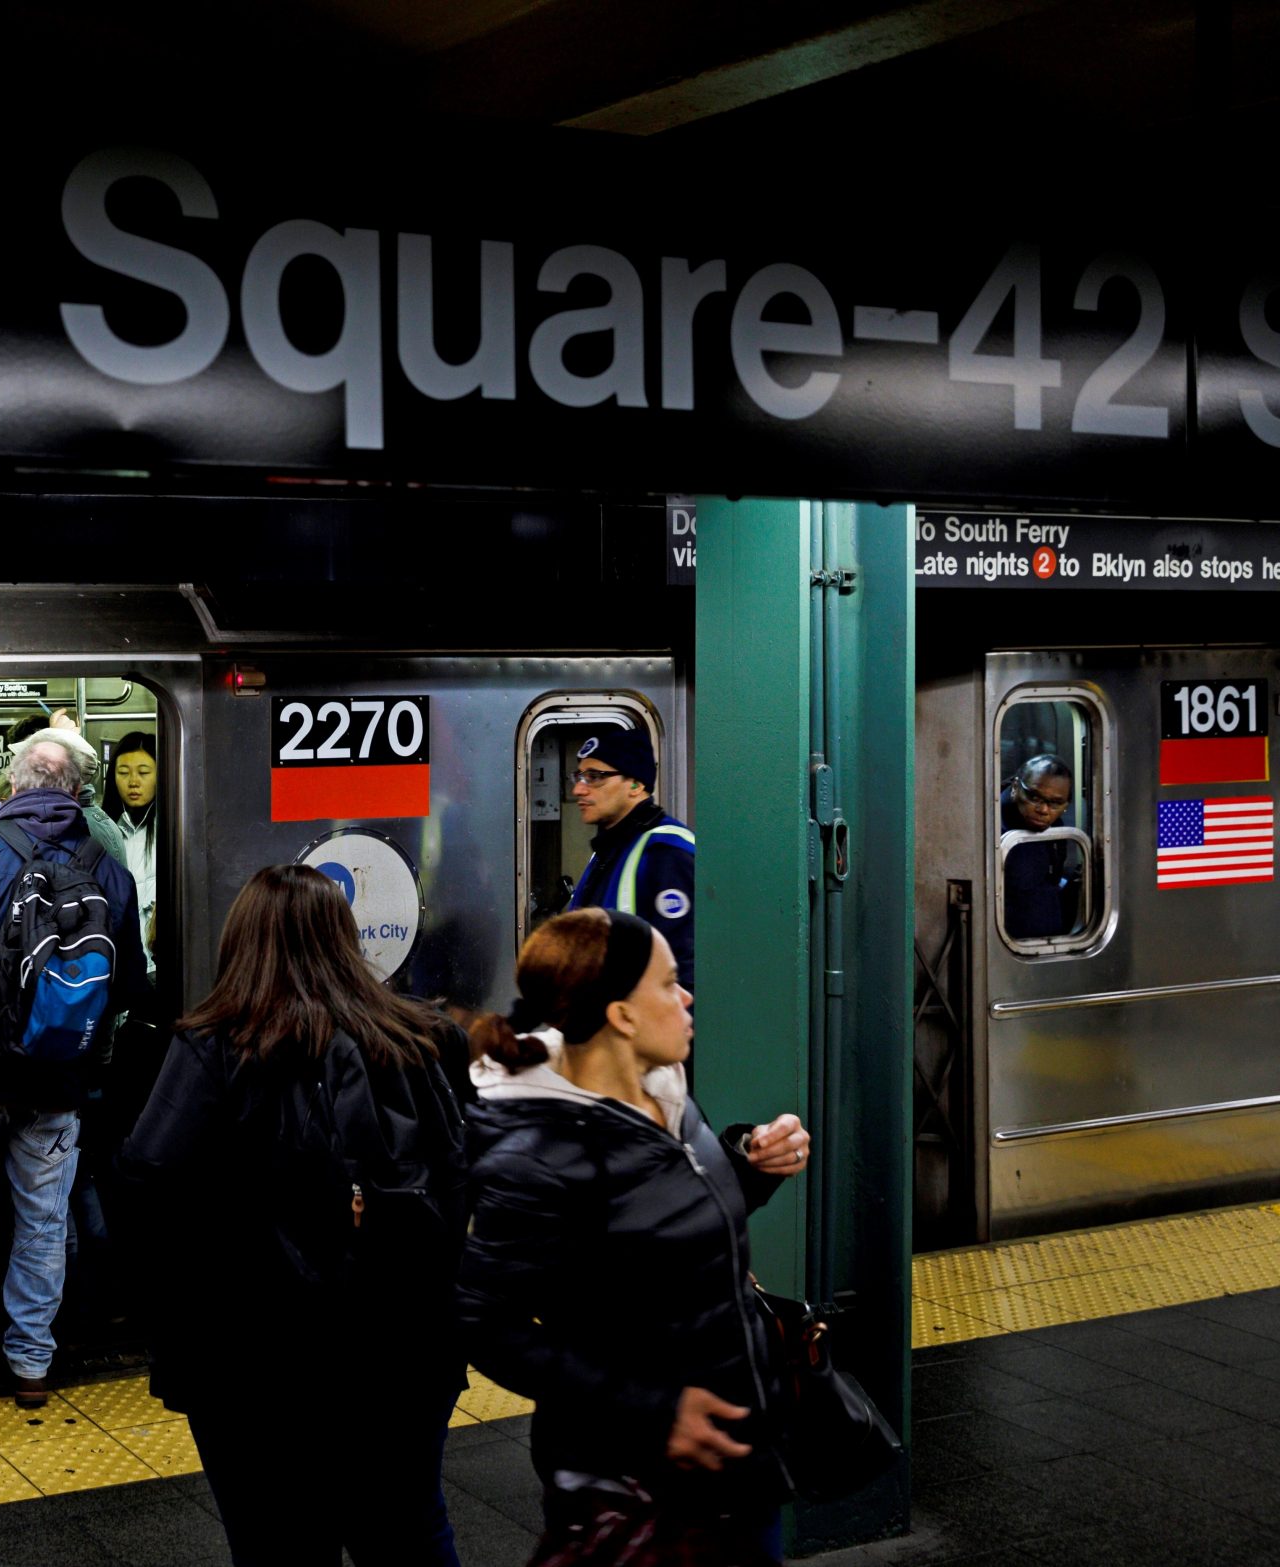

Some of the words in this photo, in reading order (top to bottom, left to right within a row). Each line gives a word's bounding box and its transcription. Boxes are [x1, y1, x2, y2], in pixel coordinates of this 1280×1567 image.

[672, 509, 697, 535] D
[915, 516, 936, 542] To
[944, 516, 1008, 543] South
[1016, 518, 1070, 548] Ferry
[966, 552, 1029, 581] nights
[1038, 554, 1050, 573] 2
[1059, 555, 1080, 577] to
[1092, 552, 1146, 581] Bklyn
[1153, 554, 1193, 579] also
[1200, 556, 1253, 583] stops
[4, 683, 28, 693] Seating
[1174, 685, 1257, 735] 1861
[279, 700, 424, 760] 2270
[380, 923, 408, 941] City
